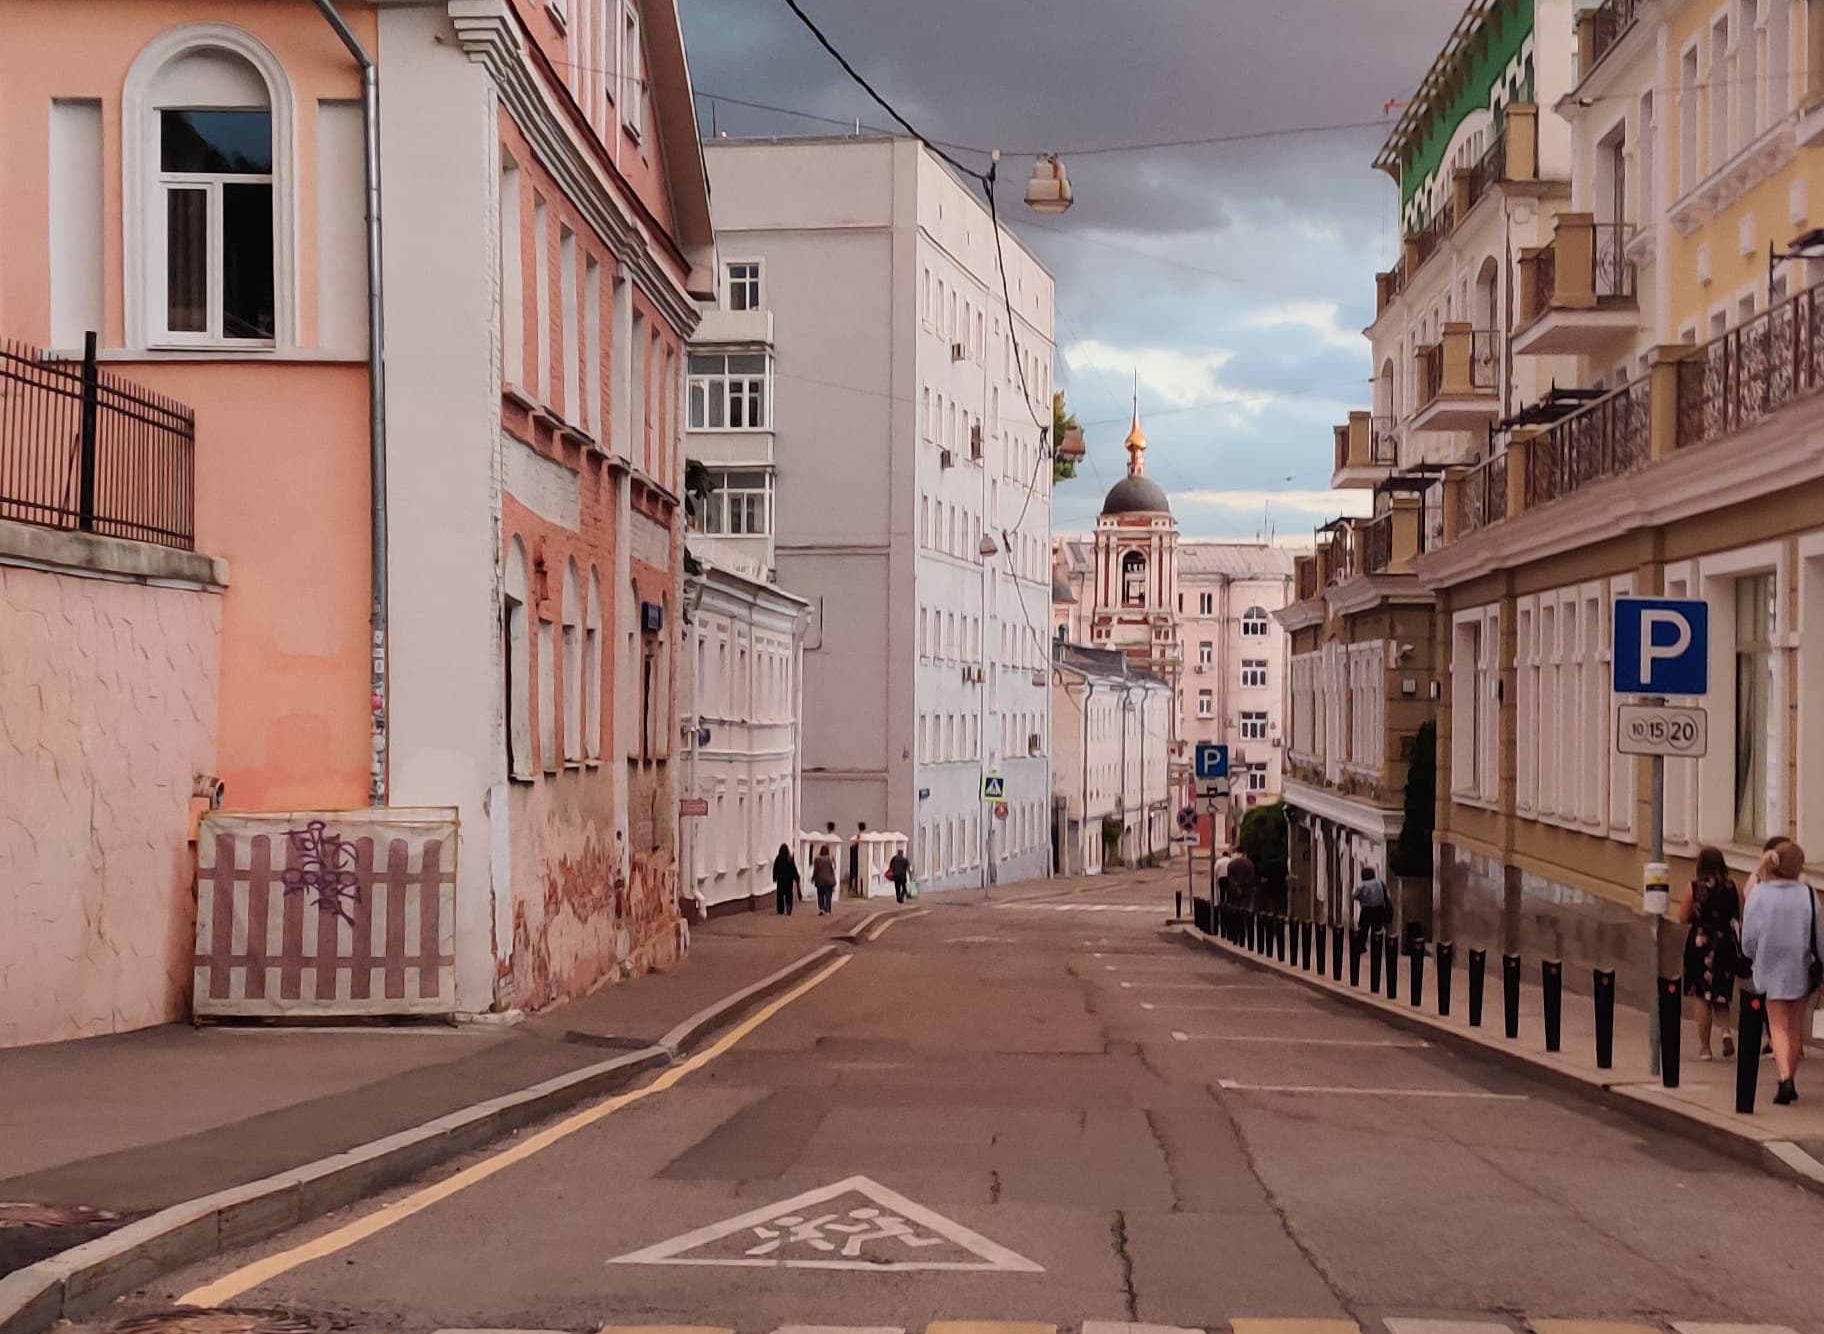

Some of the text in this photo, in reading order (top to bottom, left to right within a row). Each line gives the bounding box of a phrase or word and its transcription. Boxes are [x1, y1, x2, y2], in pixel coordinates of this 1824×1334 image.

[1640, 608, 1691, 684] P
[1632, 721, 1694, 741] 10 15 20
[1204, 749, 1220, 774] P
